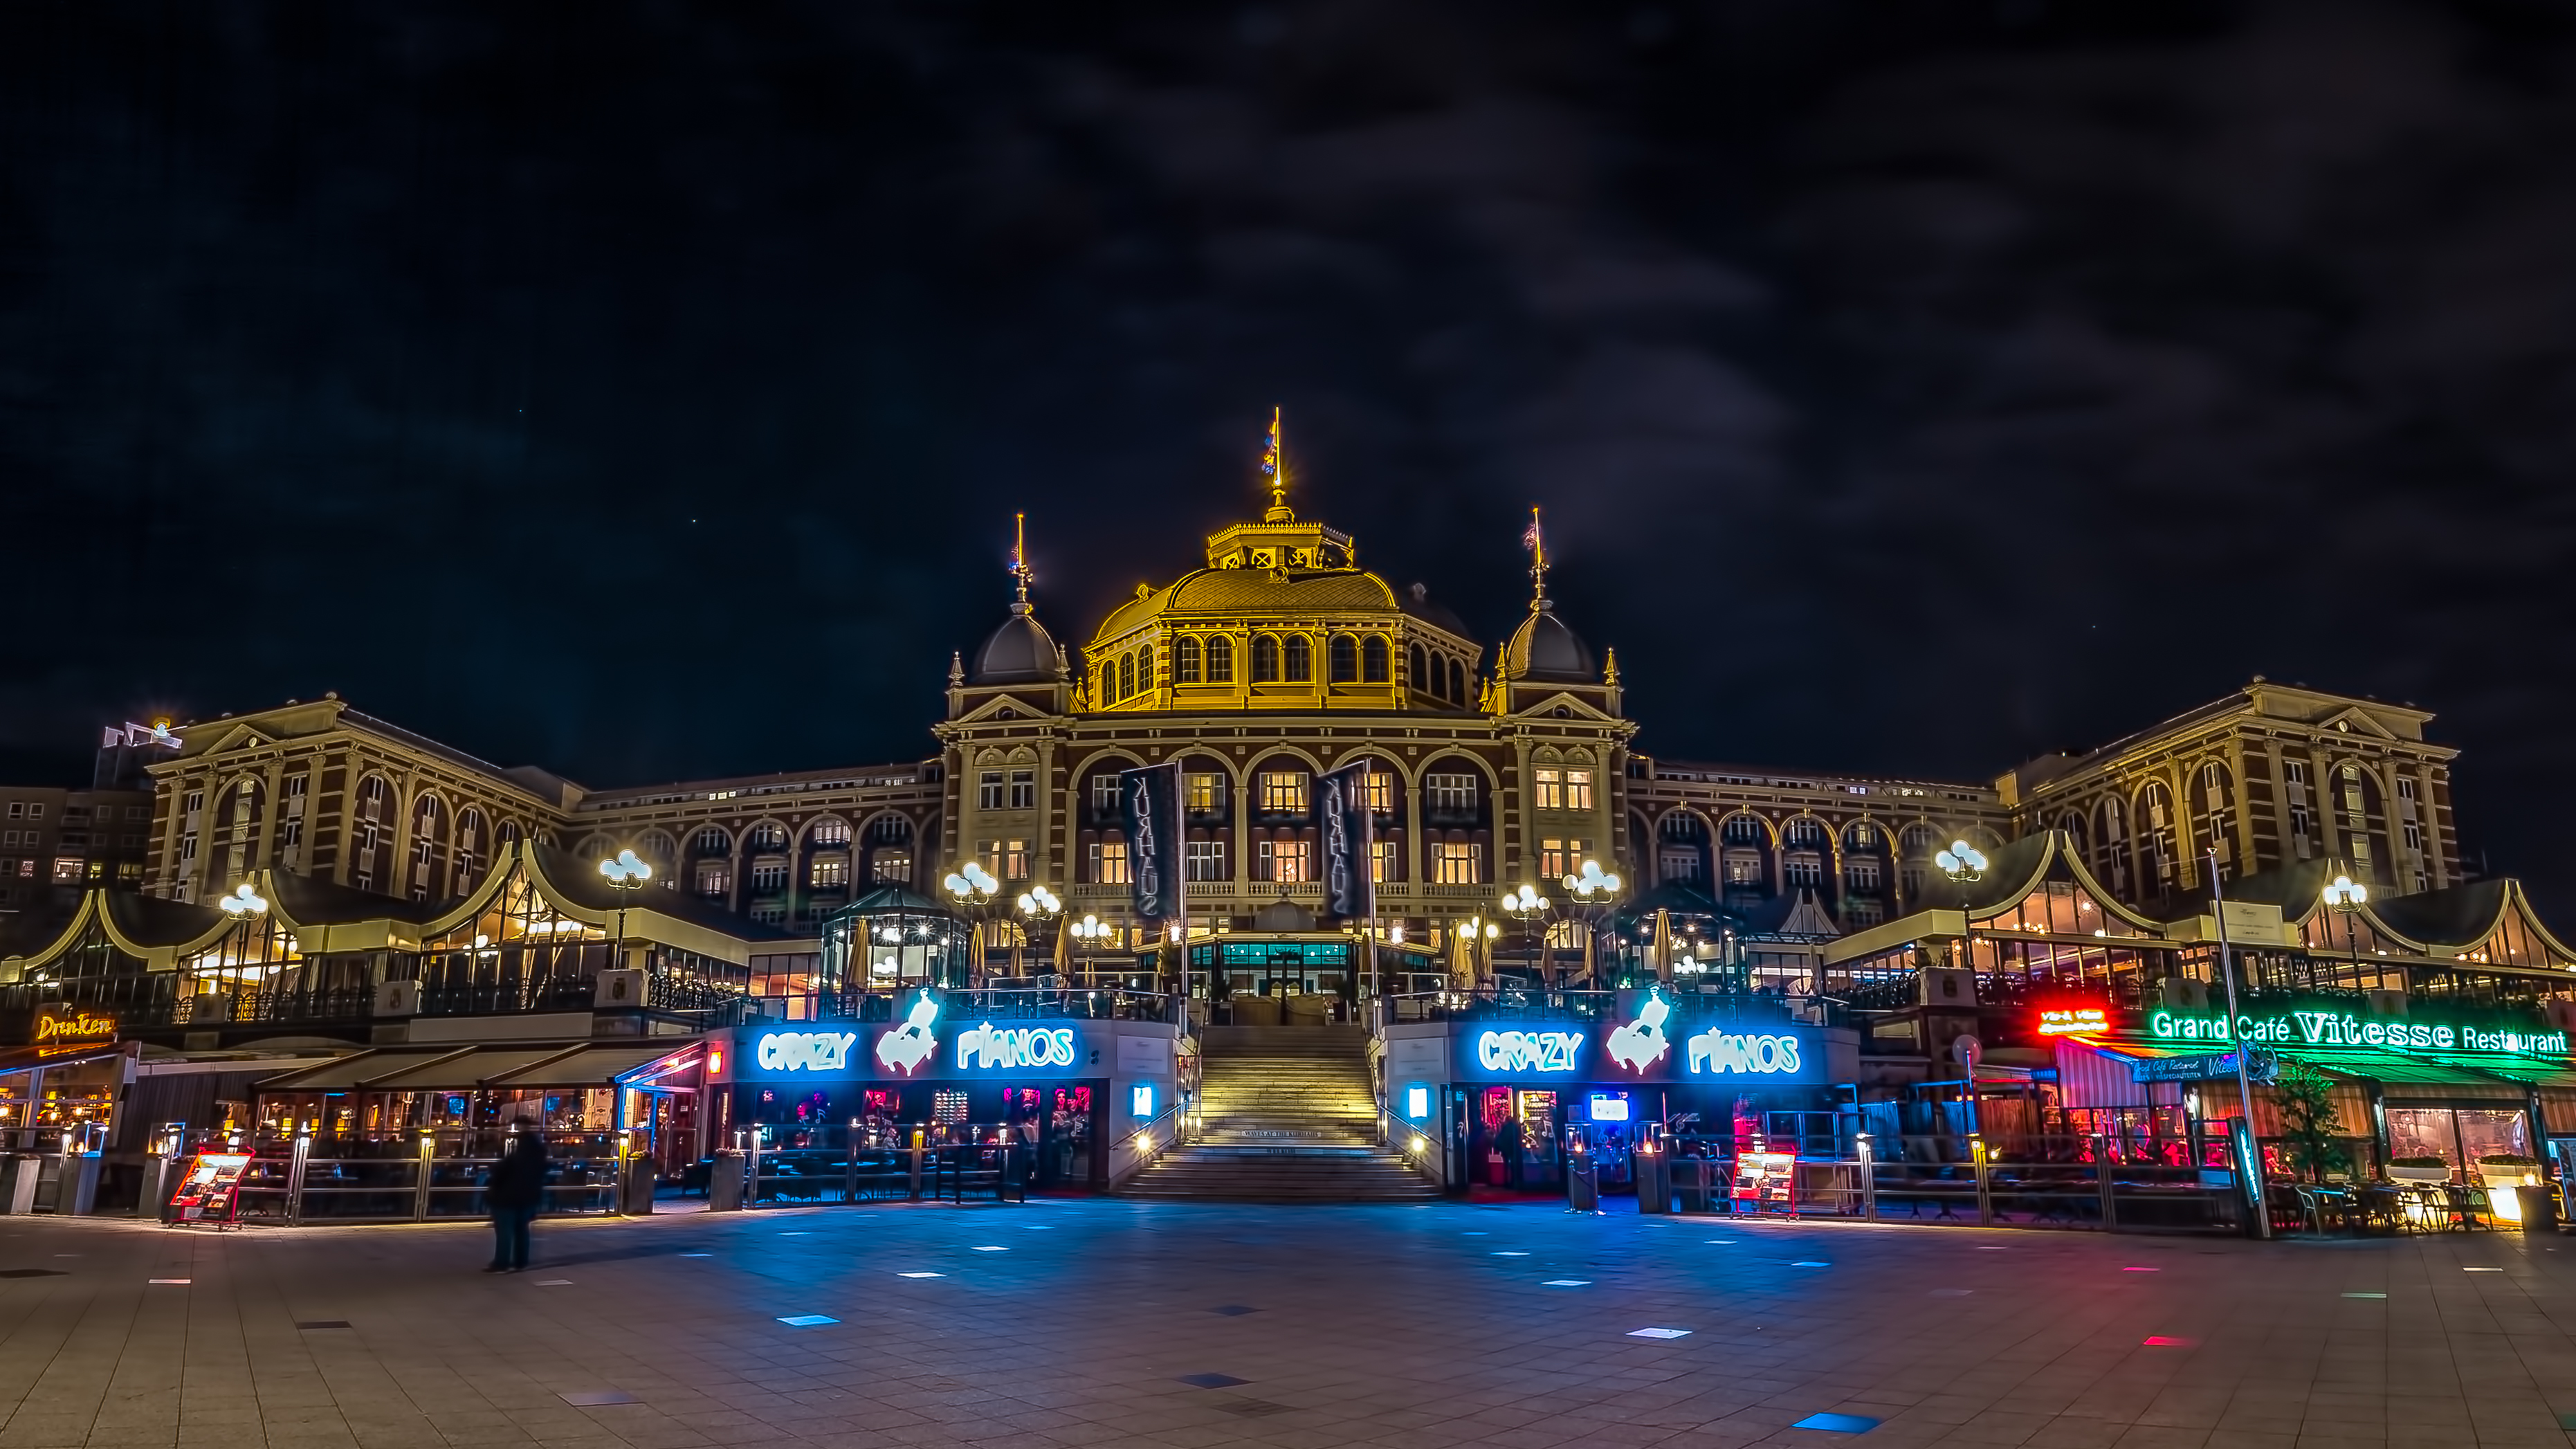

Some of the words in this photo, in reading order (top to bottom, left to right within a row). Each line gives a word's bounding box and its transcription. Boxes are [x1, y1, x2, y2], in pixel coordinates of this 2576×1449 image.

[758, 1032, 857, 1072] CRAZY
[958, 1021, 1075, 1070] PIANOS
[1479, 1031, 1584, 1072] CRAZY
[1688, 1026, 1800, 1073] PIANOS
[2153, 1011, 2230, 1039] Grand
[2237, 1015, 2290, 1041] Café
[2294, 1012, 2455, 1048] Vitesse
[2463, 1026, 2568, 1052] Restaurant
